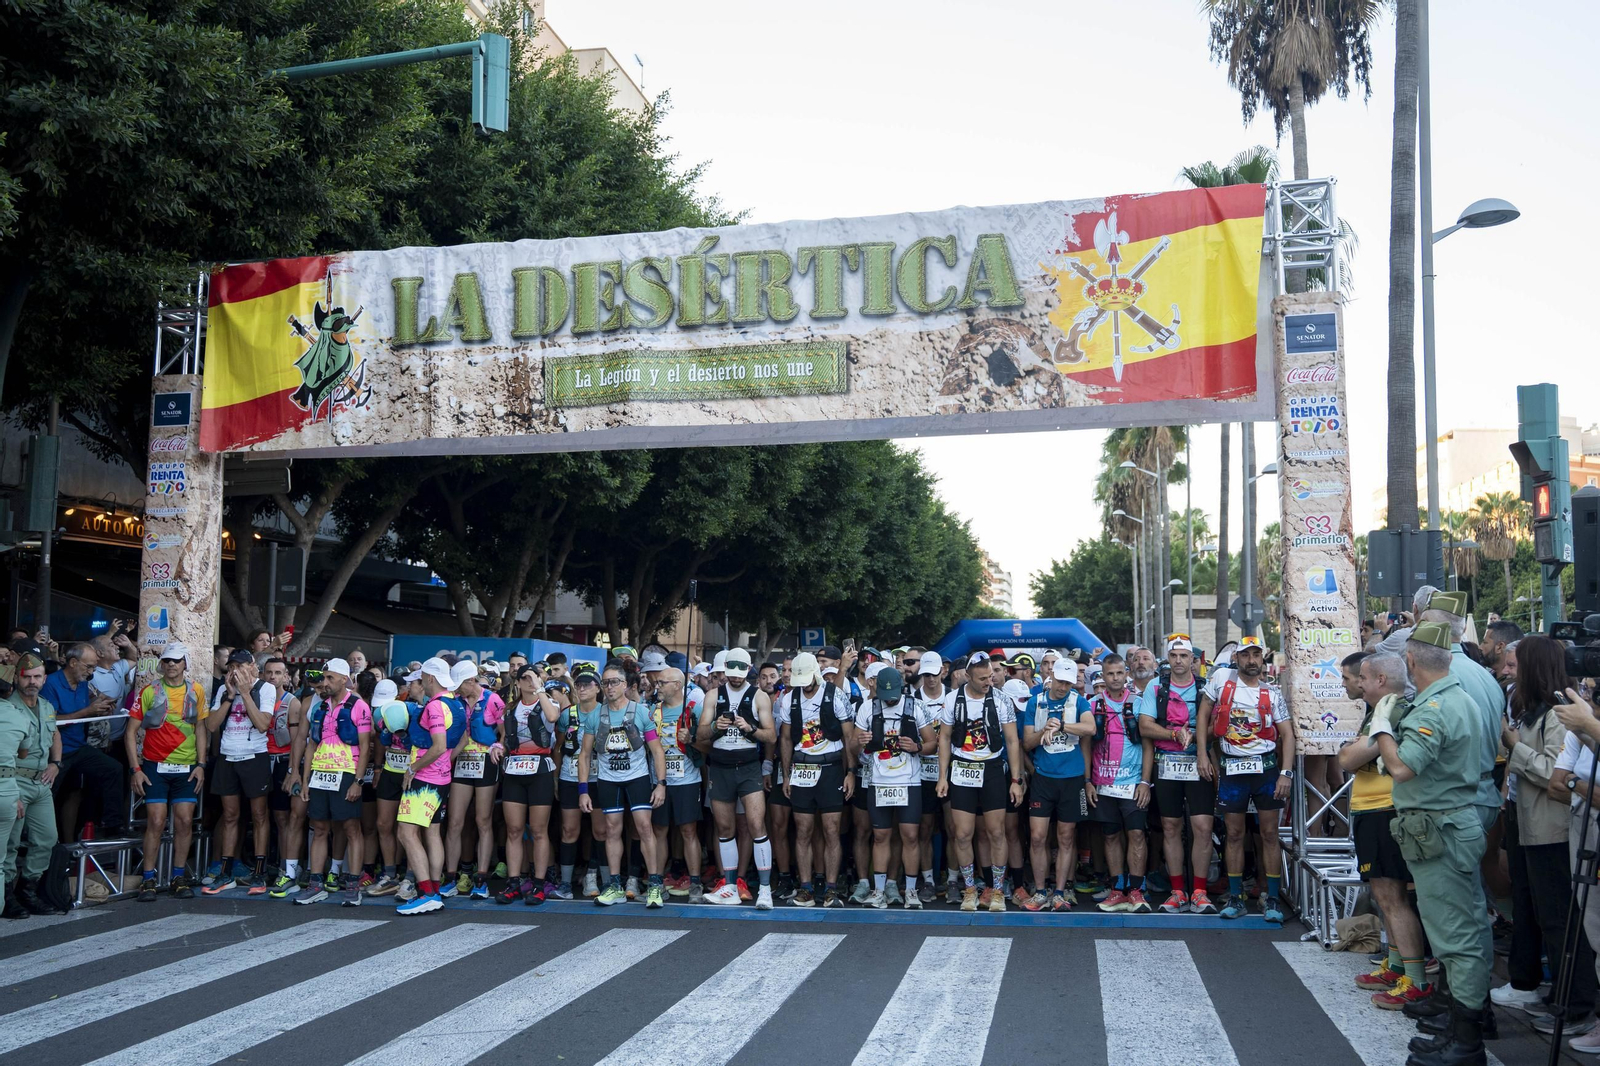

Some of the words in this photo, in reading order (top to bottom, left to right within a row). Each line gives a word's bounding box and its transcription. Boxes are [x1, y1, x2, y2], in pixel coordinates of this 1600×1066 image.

[390, 271, 494, 347] LA
[510, 234, 1026, 340] DESÉRTICA
[1296, 333, 1326, 341] SENATOR
[575, 370, 592, 388] La
[599, 364, 641, 388] Legión
[649, 368, 660, 386] y
[667, 364, 680, 383] el
[689, 361, 746, 382] desierto
[753, 363, 778, 379] nos
[787, 361, 813, 377] une
[1286, 365, 1338, 384] Coca-Cola
[1290, 396, 1337, 406] GRUPO
[1290, 405, 1339, 419] RENTA
[1290, 418, 1340, 433] TODO
[150, 436, 188, 452] Coca-Cola
[150, 470, 185, 481] RENTA
[150, 481, 185, 495] TODO
[1295, 535, 1347, 547] primaflor
[142, 579, 180, 589] primaflor
[805, 630, 819, 646] P
[390, 754, 408, 763] 4137
[461, 761, 480, 771] 4135
[514, 760, 534, 770] 1413
[609, 762, 631, 771] 3000
[1172, 763, 1194, 772] 1776
[1235, 762, 1257, 771] 1521
[797, 770, 816, 779] 4601
[959, 769, 980, 779] 4602
[1099, 766, 1130, 777] VIATOR
[318, 772, 337, 783] 4138
[882, 788, 903, 798] 4600
